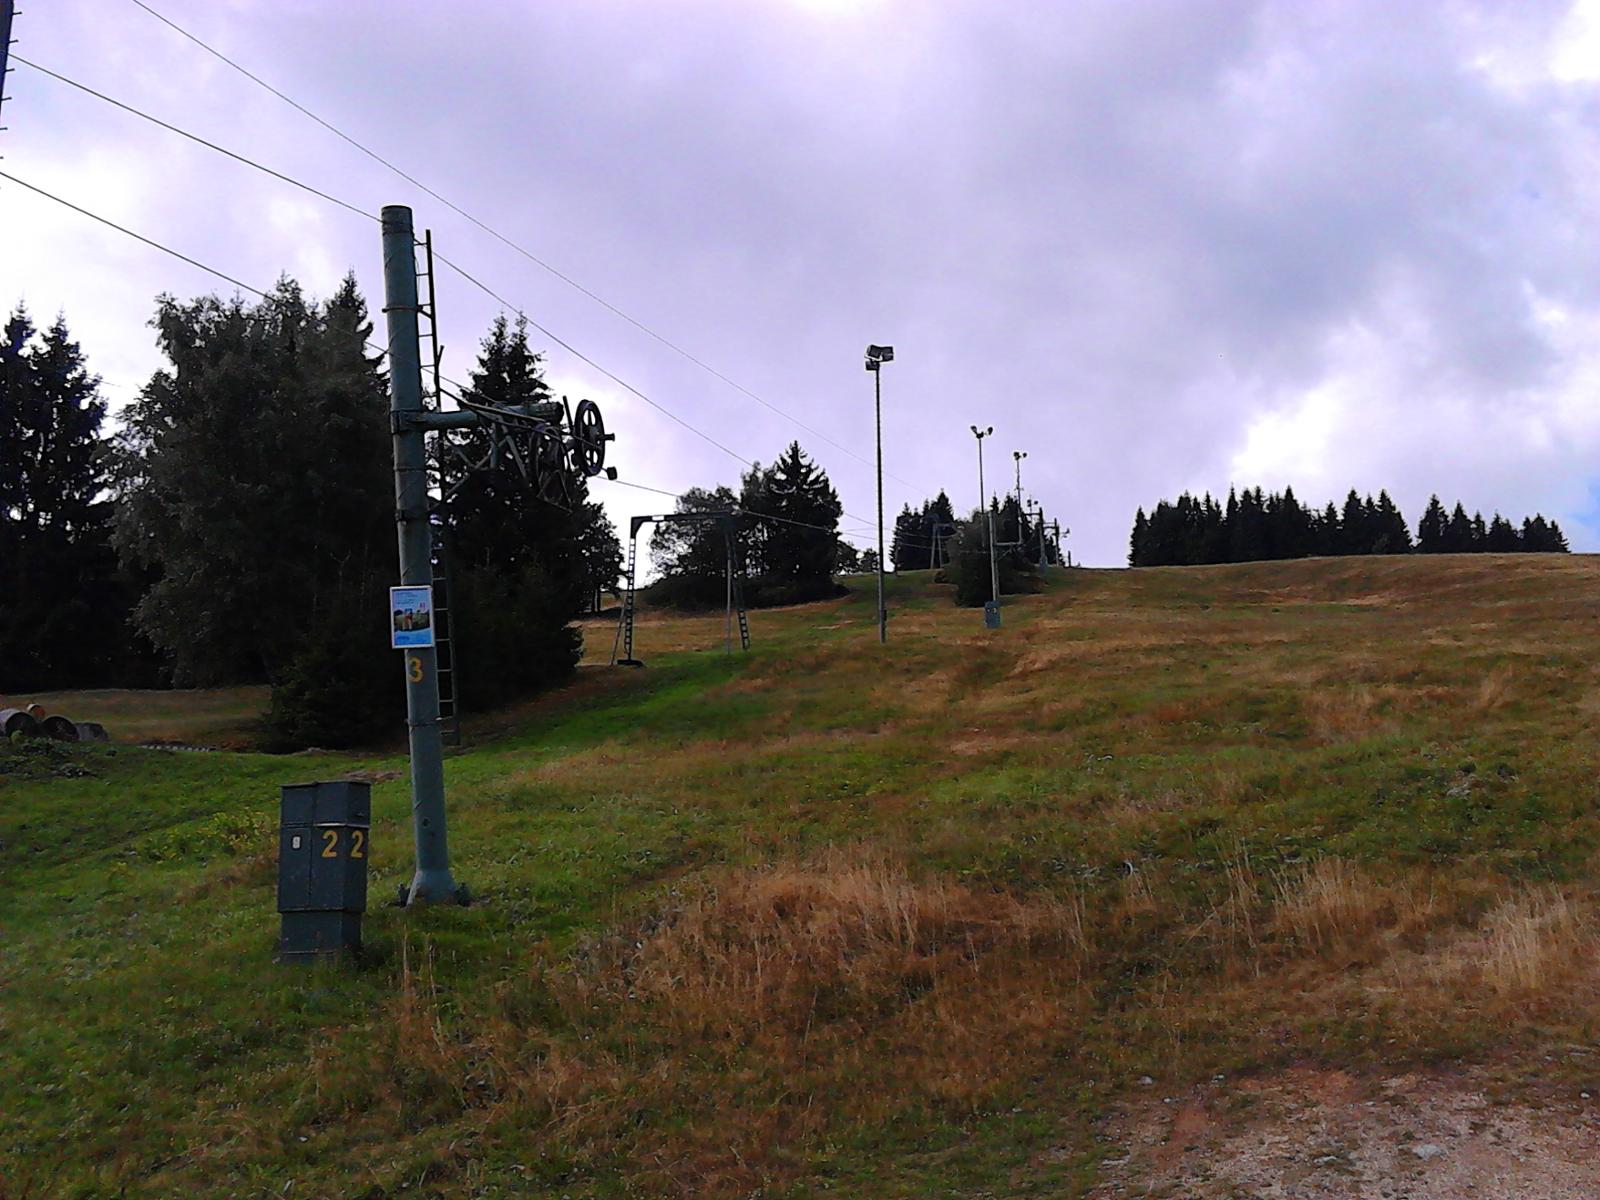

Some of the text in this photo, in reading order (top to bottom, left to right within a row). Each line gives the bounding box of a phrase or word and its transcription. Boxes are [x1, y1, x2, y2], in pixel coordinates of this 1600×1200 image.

[407, 656, 424, 683] 3
[321, 830, 338, 858] 2
[350, 830, 364, 858] 2
